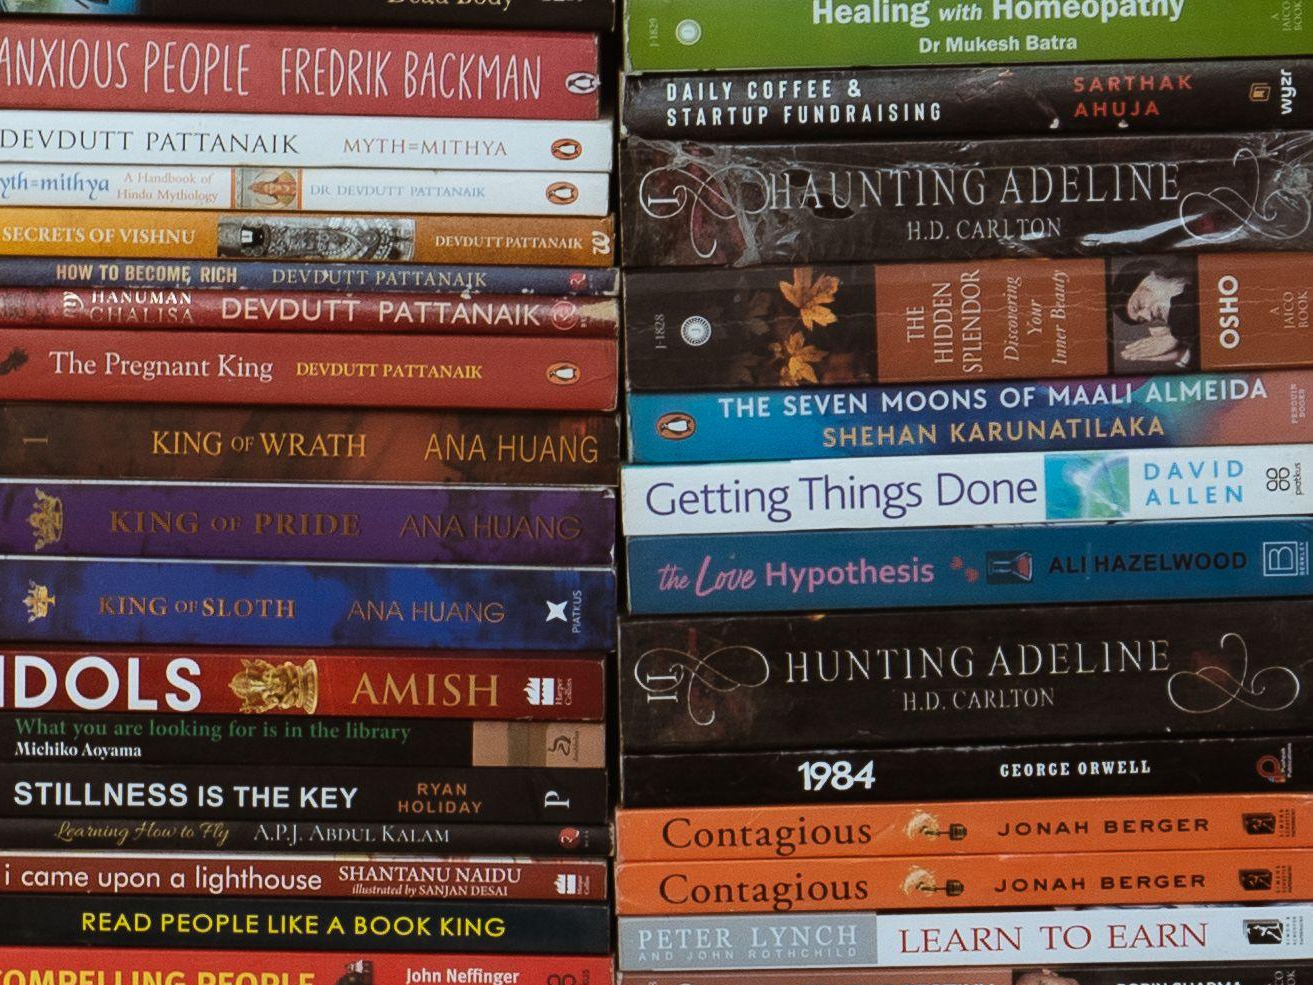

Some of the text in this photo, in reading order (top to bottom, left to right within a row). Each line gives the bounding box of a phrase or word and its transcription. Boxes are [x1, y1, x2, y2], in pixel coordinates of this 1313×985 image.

[918, 33, 1078, 54] Dr Mukesh Batra
[1073, 73, 1193, 93] SARTHAK
[1280, 68, 1294, 114] wyzr
[1073, 100, 1160, 119] AHUJA
[123, 171, 213, 186] A Handbook of
[116, 187, 219, 204] Hindu Mythology
[56, 264, 238, 284] HOW TO BECOME RICH
[49, 351, 273, 383] The Pregnant King
[1048, 551, 1247, 574] ALI HAZELWOOD
[902, 686, 1055, 711] H.D. CARLTON
[14, 740, 142, 760] Michiko Aoyama
[797, 760, 876, 791] 1984
[1000, 759, 1152, 778] GEORGE ORWELL
[997, 816, 1209, 838] JONAH BERGER
[351, 883, 508, 899] illustrated by SANJAN DESAI
